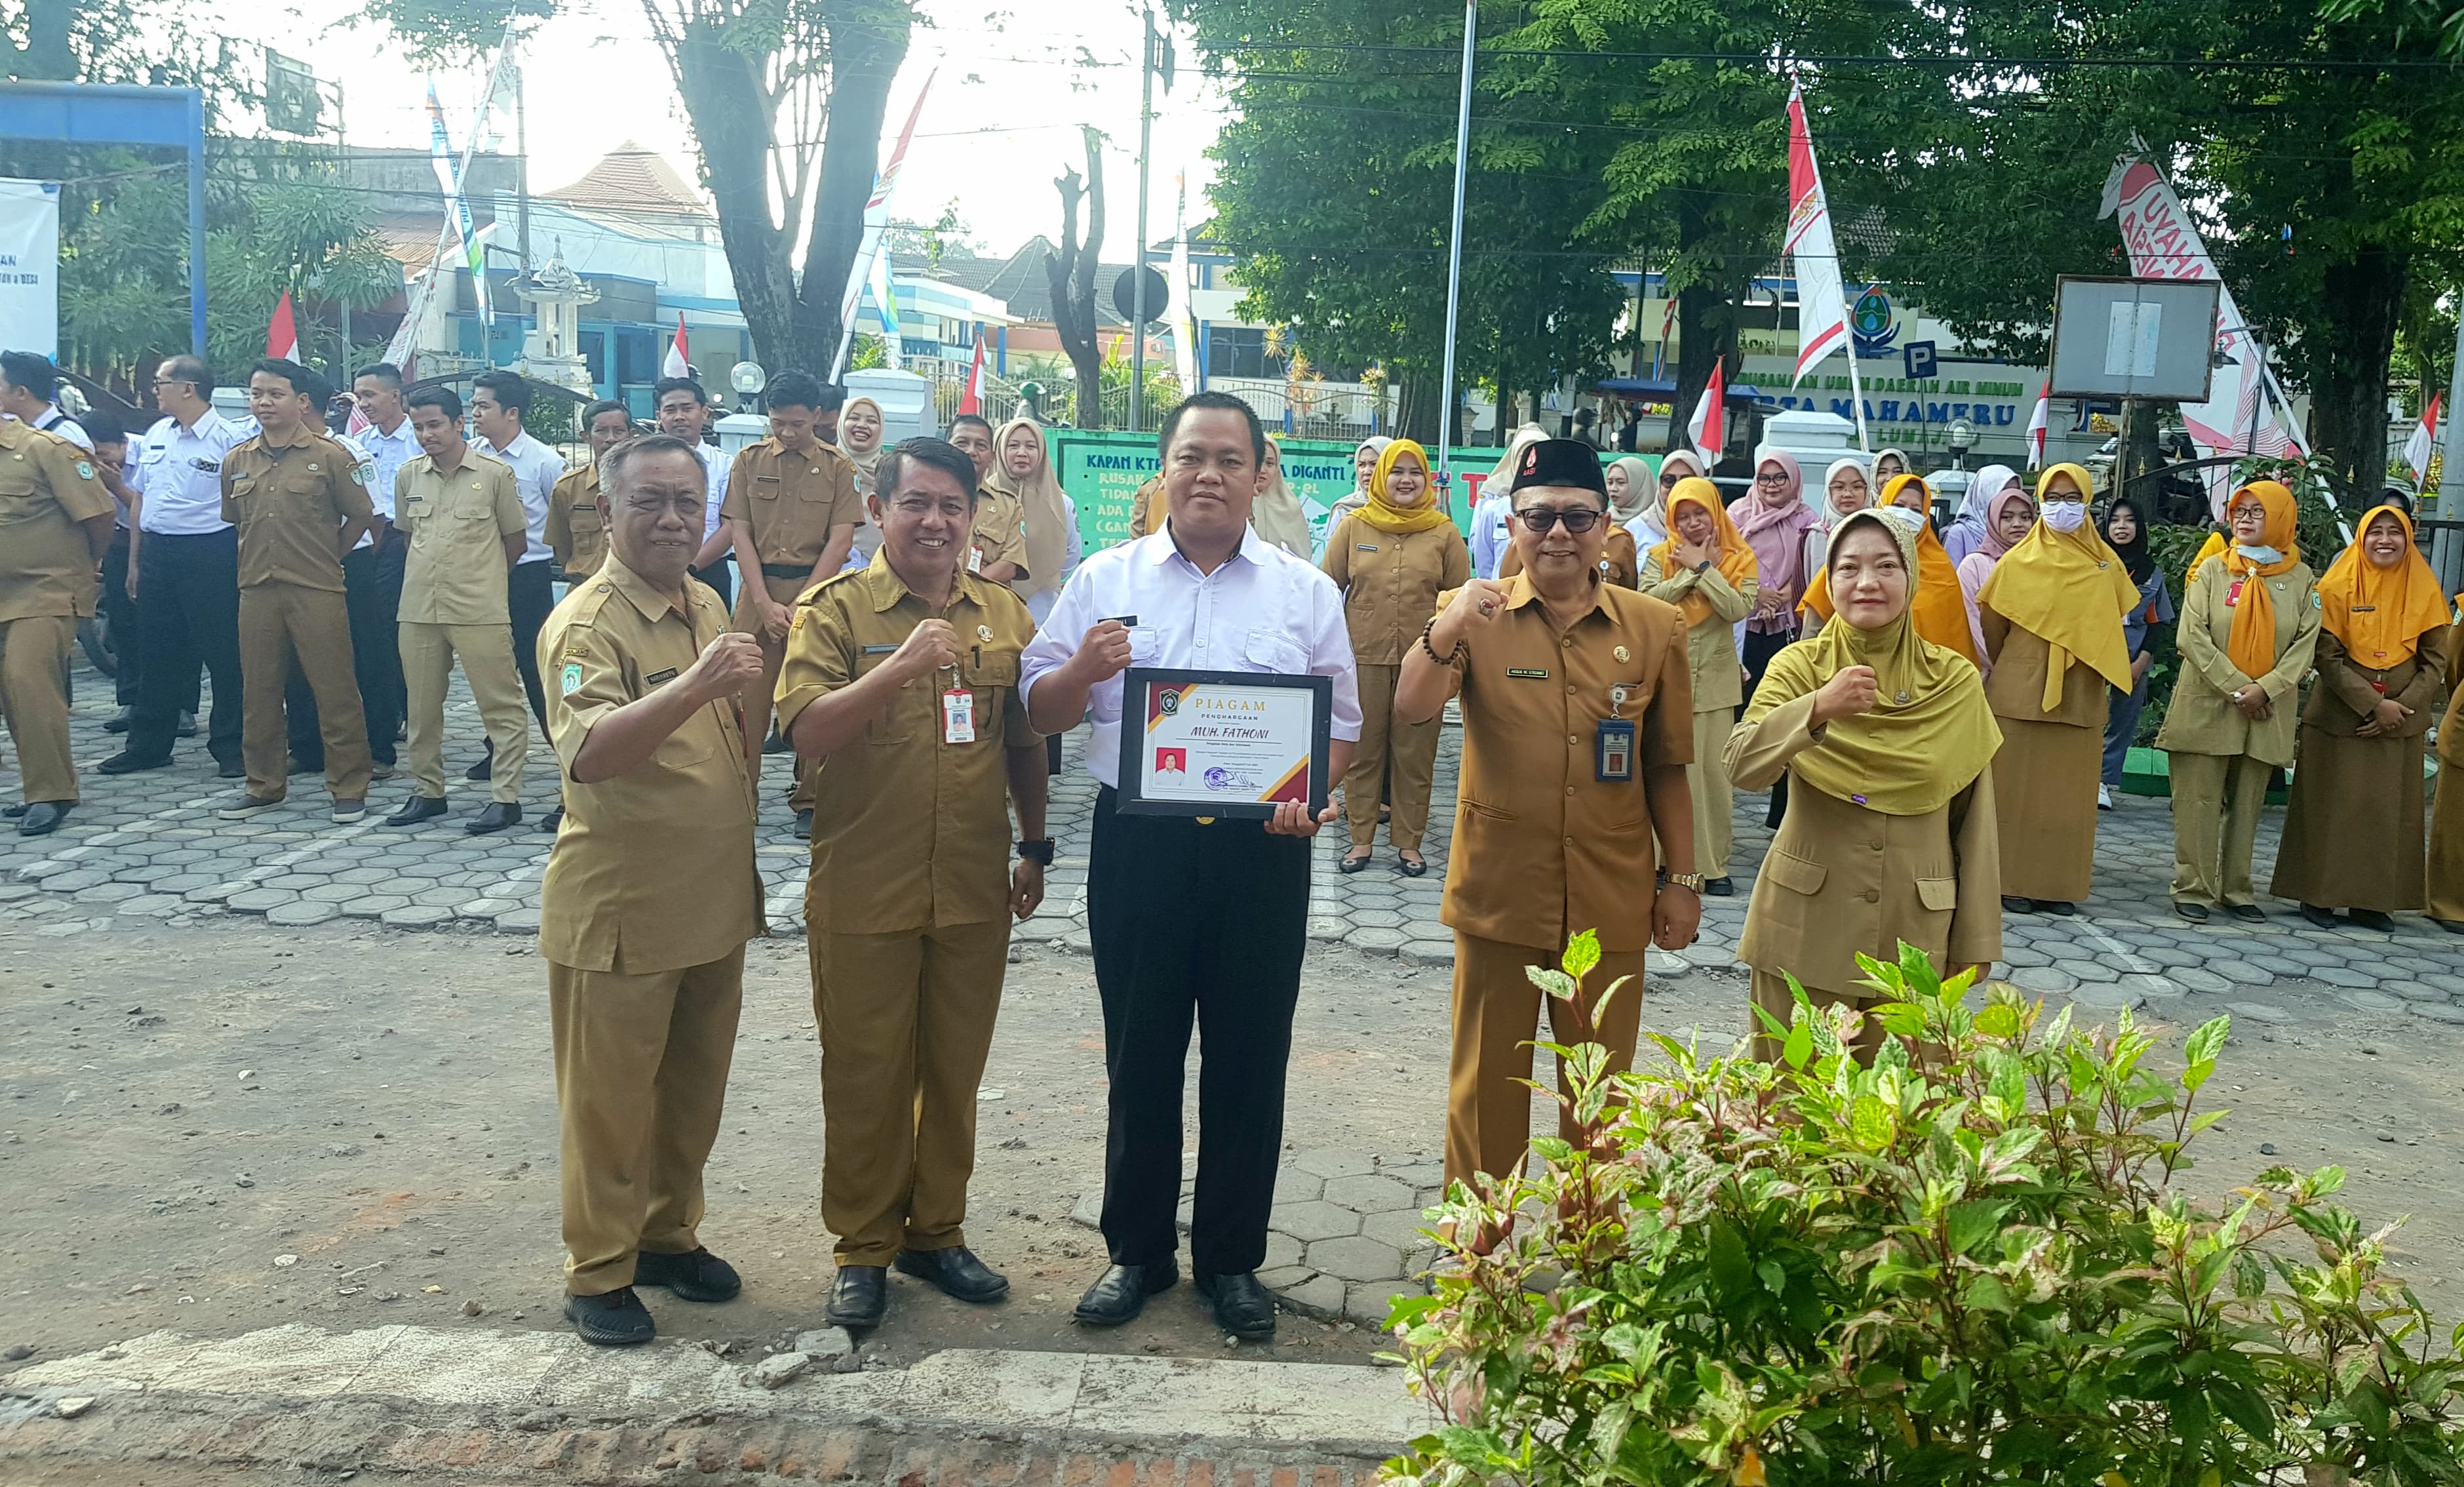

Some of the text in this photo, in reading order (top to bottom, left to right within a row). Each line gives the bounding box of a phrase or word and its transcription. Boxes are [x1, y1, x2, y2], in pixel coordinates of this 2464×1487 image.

[1909, 346, 1930, 374] P
[1825, 375, 1871, 391] UMM
[1946, 380, 1970, 394] AIR
[1975, 381, 2024, 396] MINUM
[1829, 397, 2016, 426] MAHAMERU
[1087, 454, 1131, 469] KAPAN
[1292, 464, 1345, 481] DIGANTI
[1099, 473, 1145, 486] RUSAK
[1097, 504, 1124, 517] ADA
[1195, 698, 1266, 711] PIAGAM
[1190, 726, 1270, 739] MUH. FATHONI
